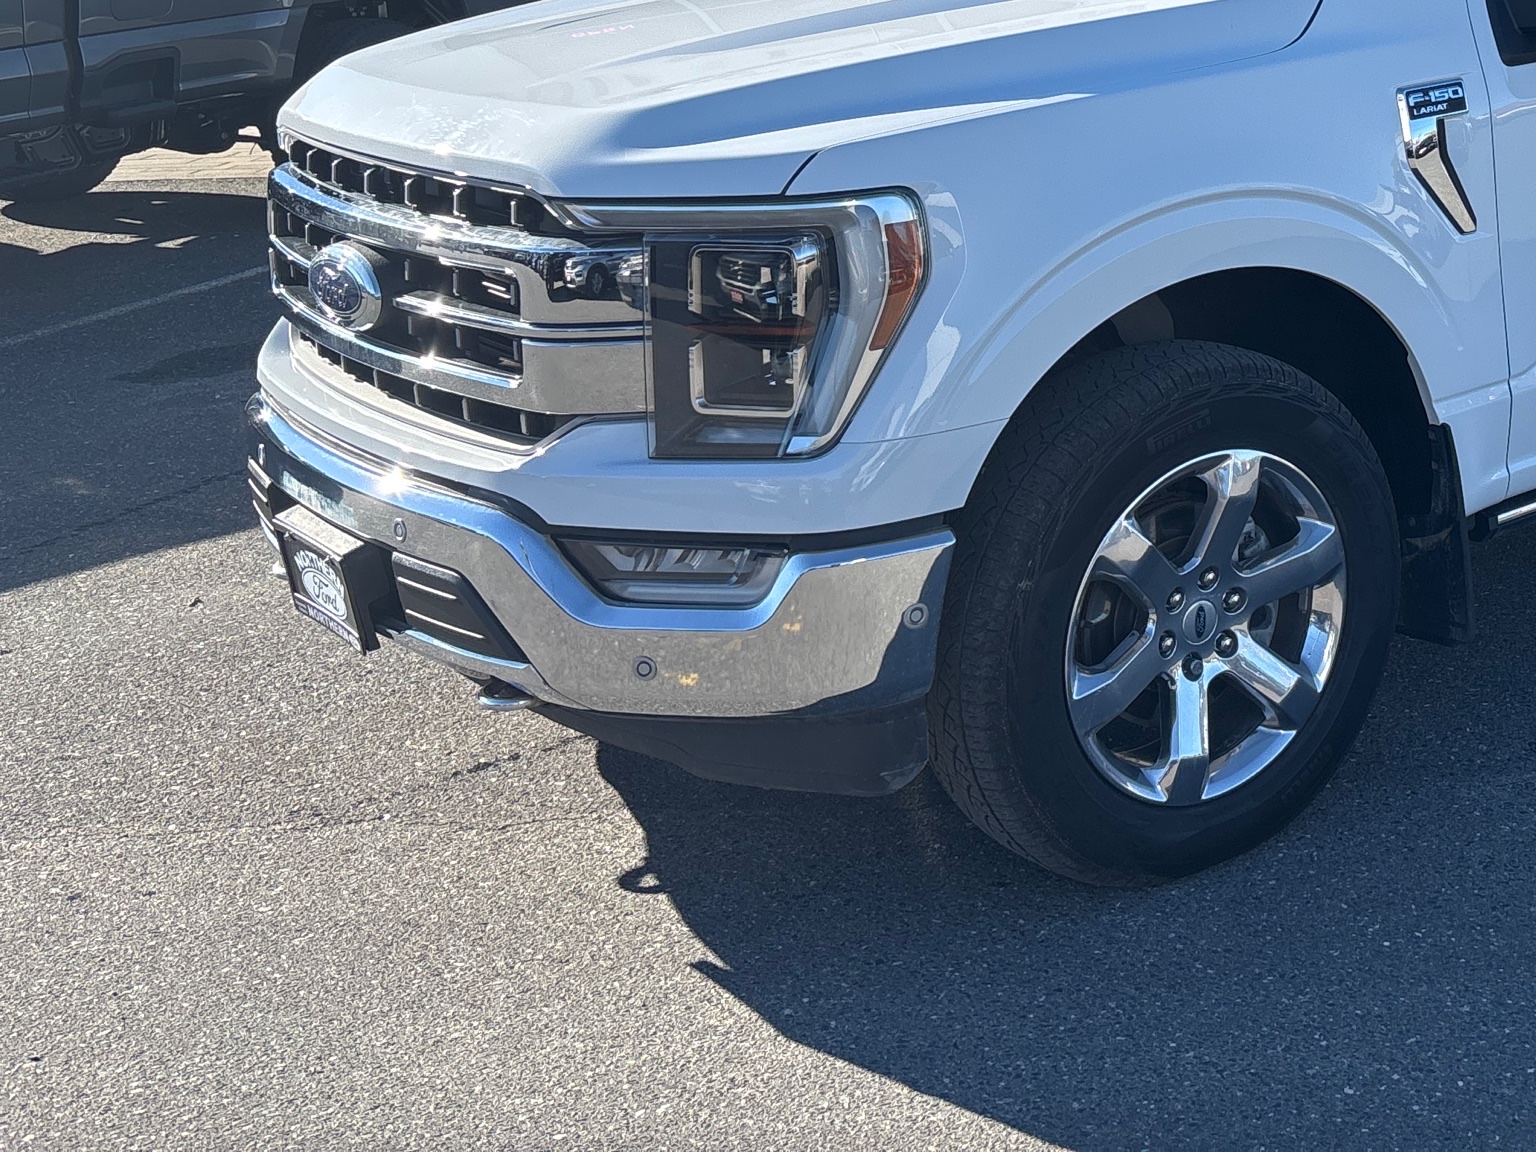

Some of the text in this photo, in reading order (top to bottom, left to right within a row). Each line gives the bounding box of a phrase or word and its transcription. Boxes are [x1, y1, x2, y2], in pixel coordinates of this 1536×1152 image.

[1408, 86, 1463, 107] F-150
[1413, 103, 1449, 116] LARIAT
[293, 549, 345, 599] NORTHERN
[312, 574, 341, 612] Ford
[307, 604, 350, 642] NORTHERN
